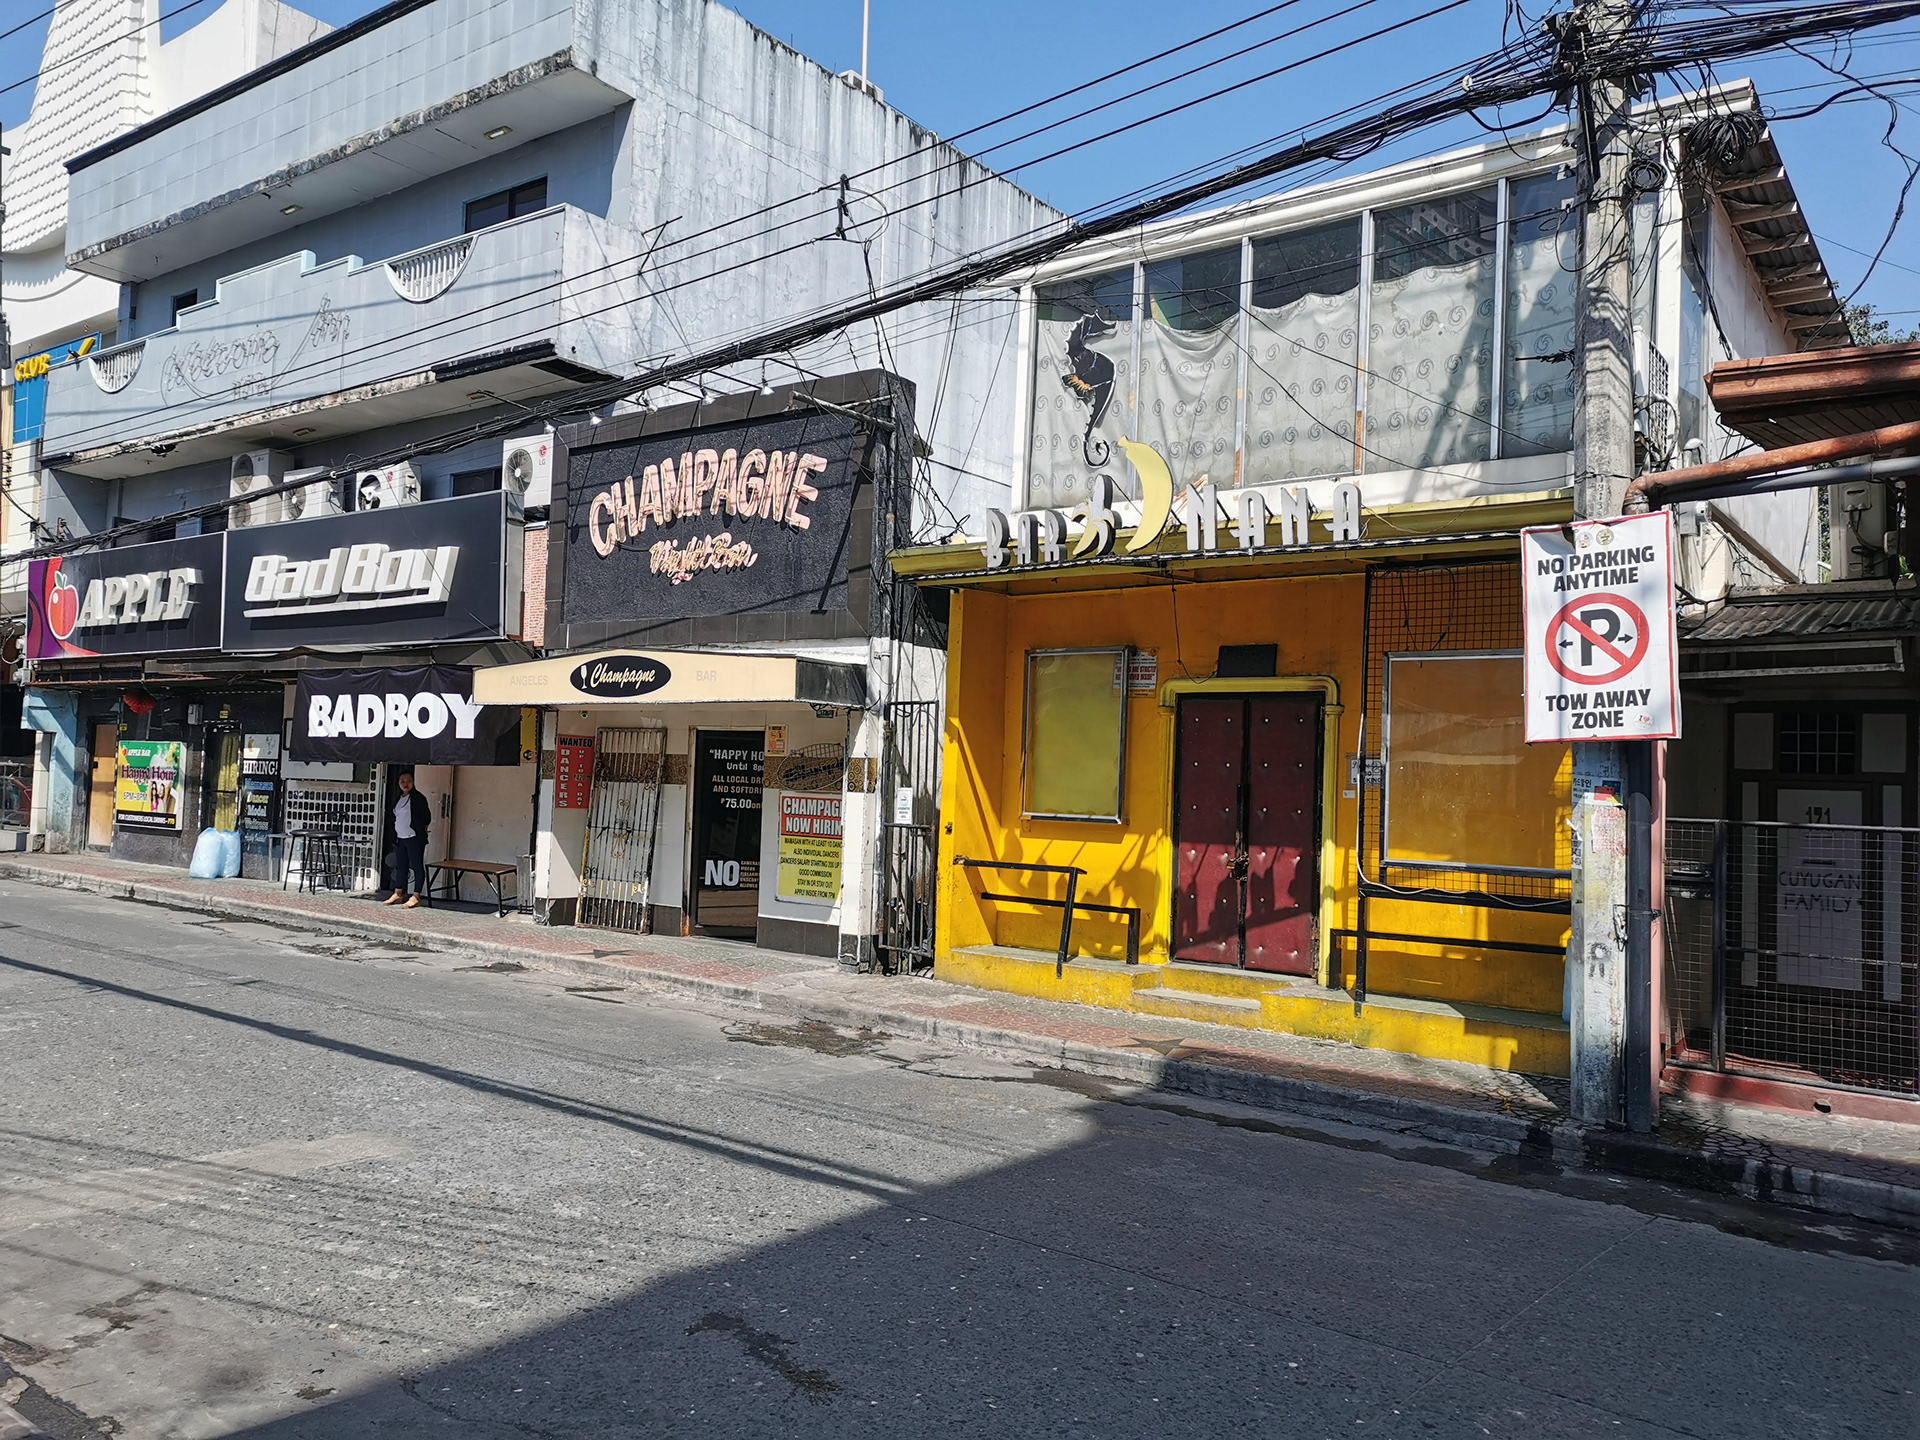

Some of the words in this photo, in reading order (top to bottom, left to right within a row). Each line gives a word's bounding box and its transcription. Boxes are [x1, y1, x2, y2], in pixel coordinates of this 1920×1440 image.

[15, 354, 51, 383] CLUB
[589, 448, 828, 557] CHAMPAGNE
[982, 508, 1067, 569] BAR
[1537, 556, 1565, 577] NO
[1569, 545, 1655, 572] PARKING
[1553, 566, 1639, 593] ANYTIME
[76, 567, 203, 628] APPLE
[510, 675, 549, 687] ANGELES
[590, 663, 656, 690] Champagne
[696, 670, 717, 682] BAR
[1545, 692, 1588, 712] TOW
[1592, 688, 1651, 709] AWAY
[308, 691, 483, 740] BADBOY
[1571, 710, 1624, 730] ZONE
[560, 737, 593, 748] WANTED
[121, 764, 150, 785] Happy
[152, 765, 177, 781] Hour
[243, 759, 279, 776] HIRING!
[726, 761, 748, 771] Until
[559, 748, 571, 808] DANCERS
[712, 774, 725, 783] ALL
[726, 775, 749, 784] LOCAL
[712, 785, 729, 793] AND
[248, 804, 267, 817] Model
[786, 816, 811, 834] NOW
[812, 818, 842, 837] HIRIN
[704, 859, 740, 887] NO
[1779, 871, 1860, 890] CUYUGAN
[1784, 893, 1852, 913] FAMILY
